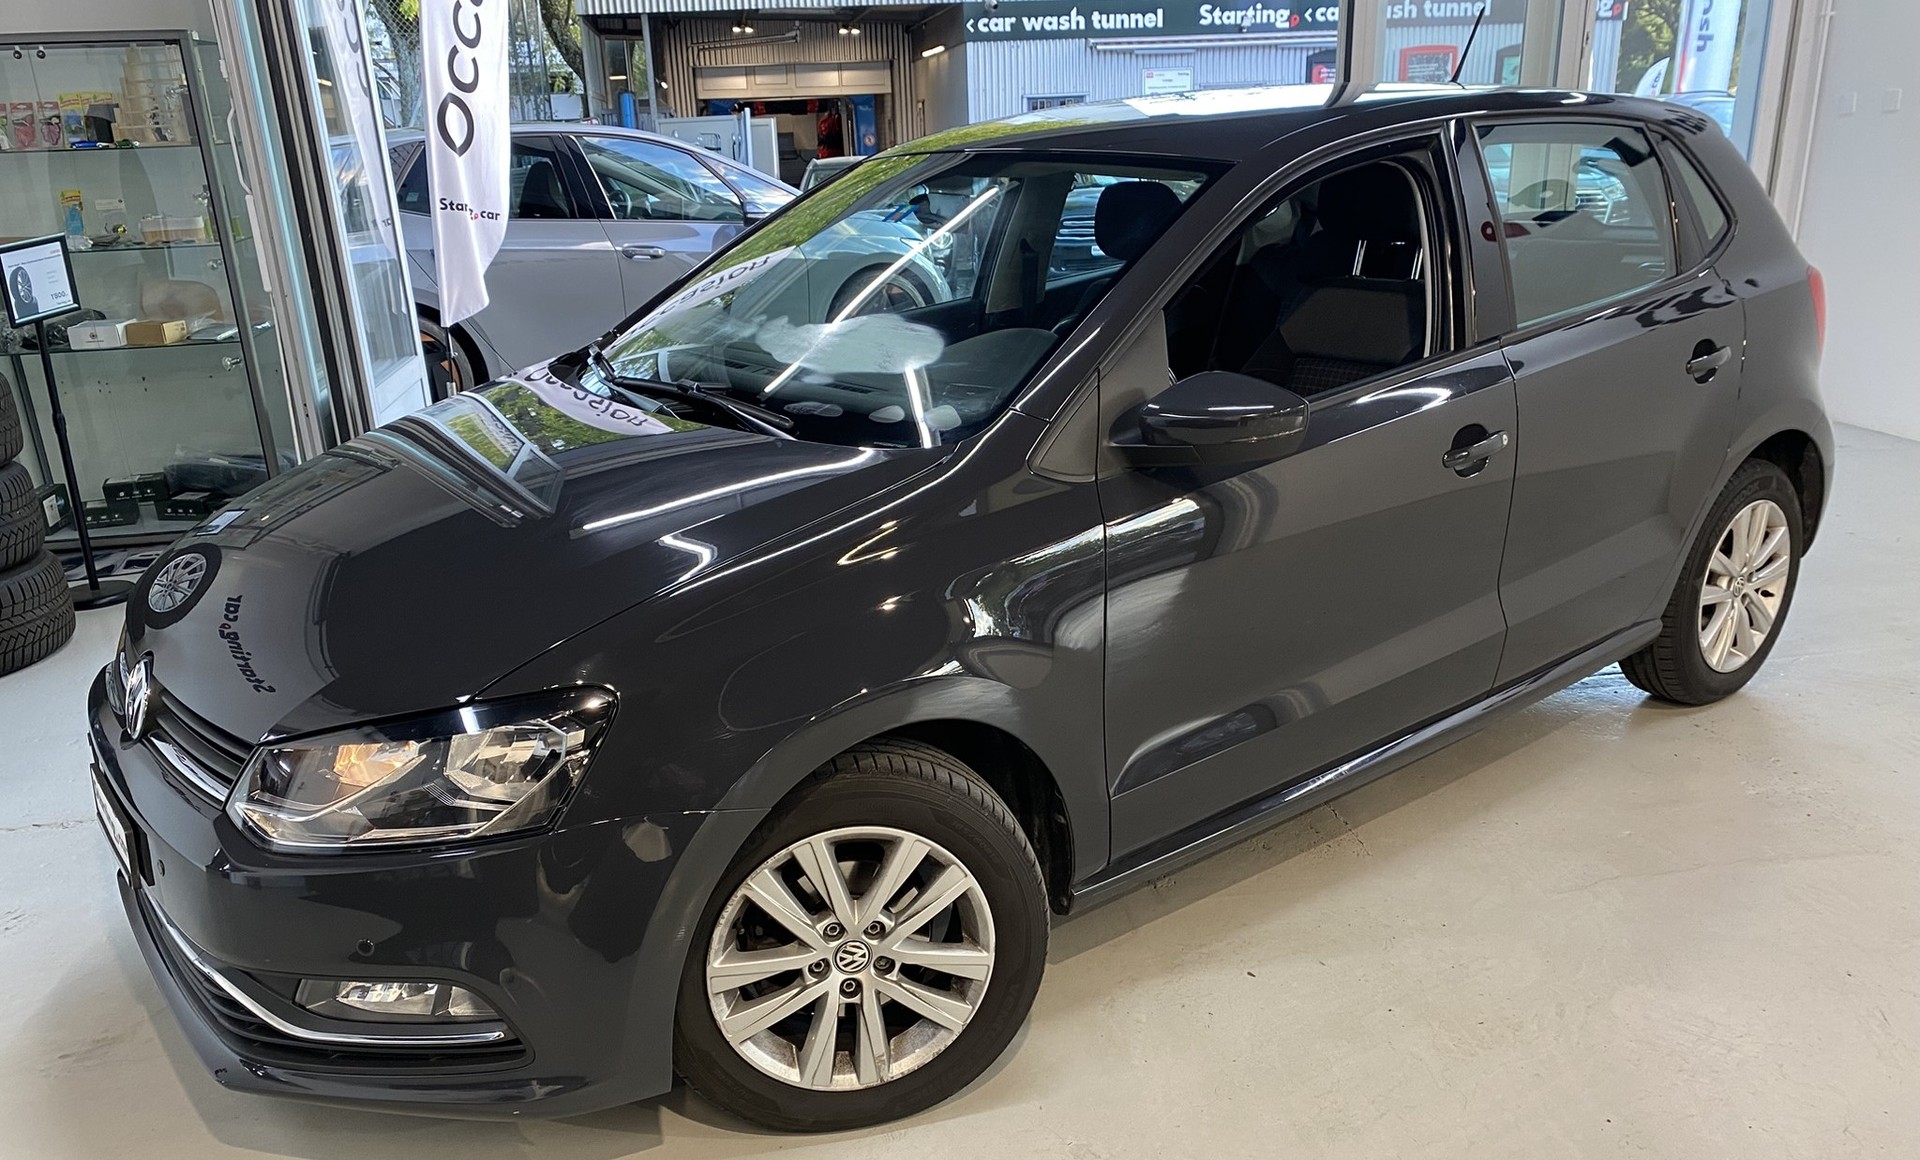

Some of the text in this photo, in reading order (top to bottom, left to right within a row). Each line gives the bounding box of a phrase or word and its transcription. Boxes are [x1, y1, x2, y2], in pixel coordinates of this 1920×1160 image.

[977, 6, 1164, 33] car wash tunnel
[1199, 2, 1291, 29] Starting
[1315, 6, 1340, 23] ca
[1424, 0, 1492, 17] tunnel
[436, 0, 483, 158] Occ
[480, 210, 501, 221] car
